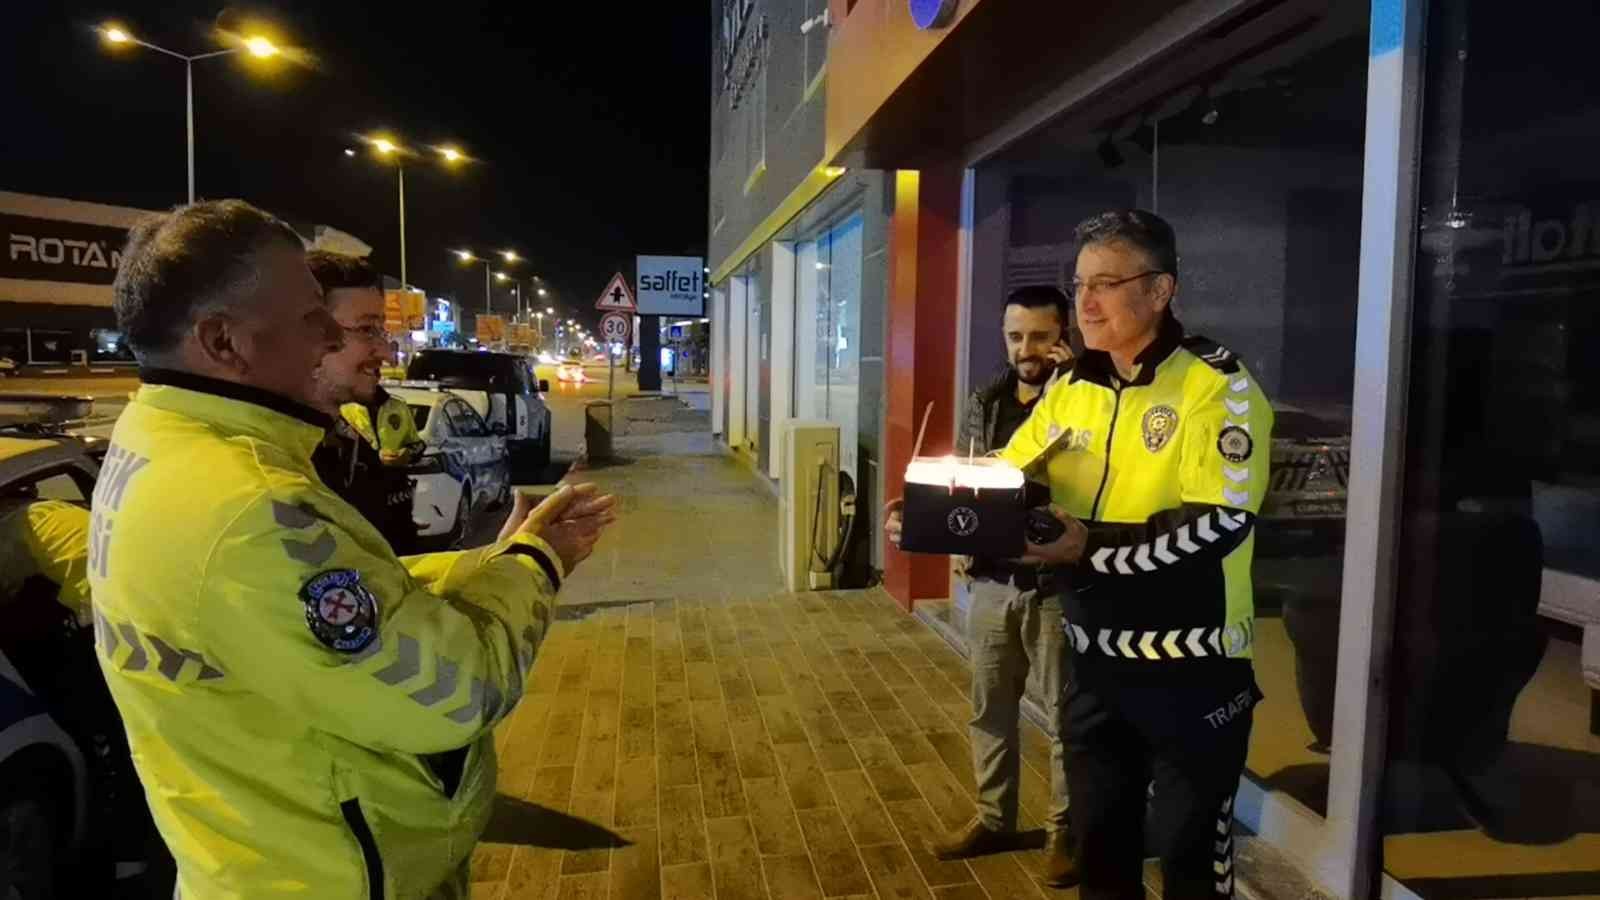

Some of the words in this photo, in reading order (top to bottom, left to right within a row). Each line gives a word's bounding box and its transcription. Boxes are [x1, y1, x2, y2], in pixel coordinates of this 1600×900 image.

[640, 270, 700, 292] saffet
[606, 319, 625, 335] 30
[956, 514, 970, 530] V
